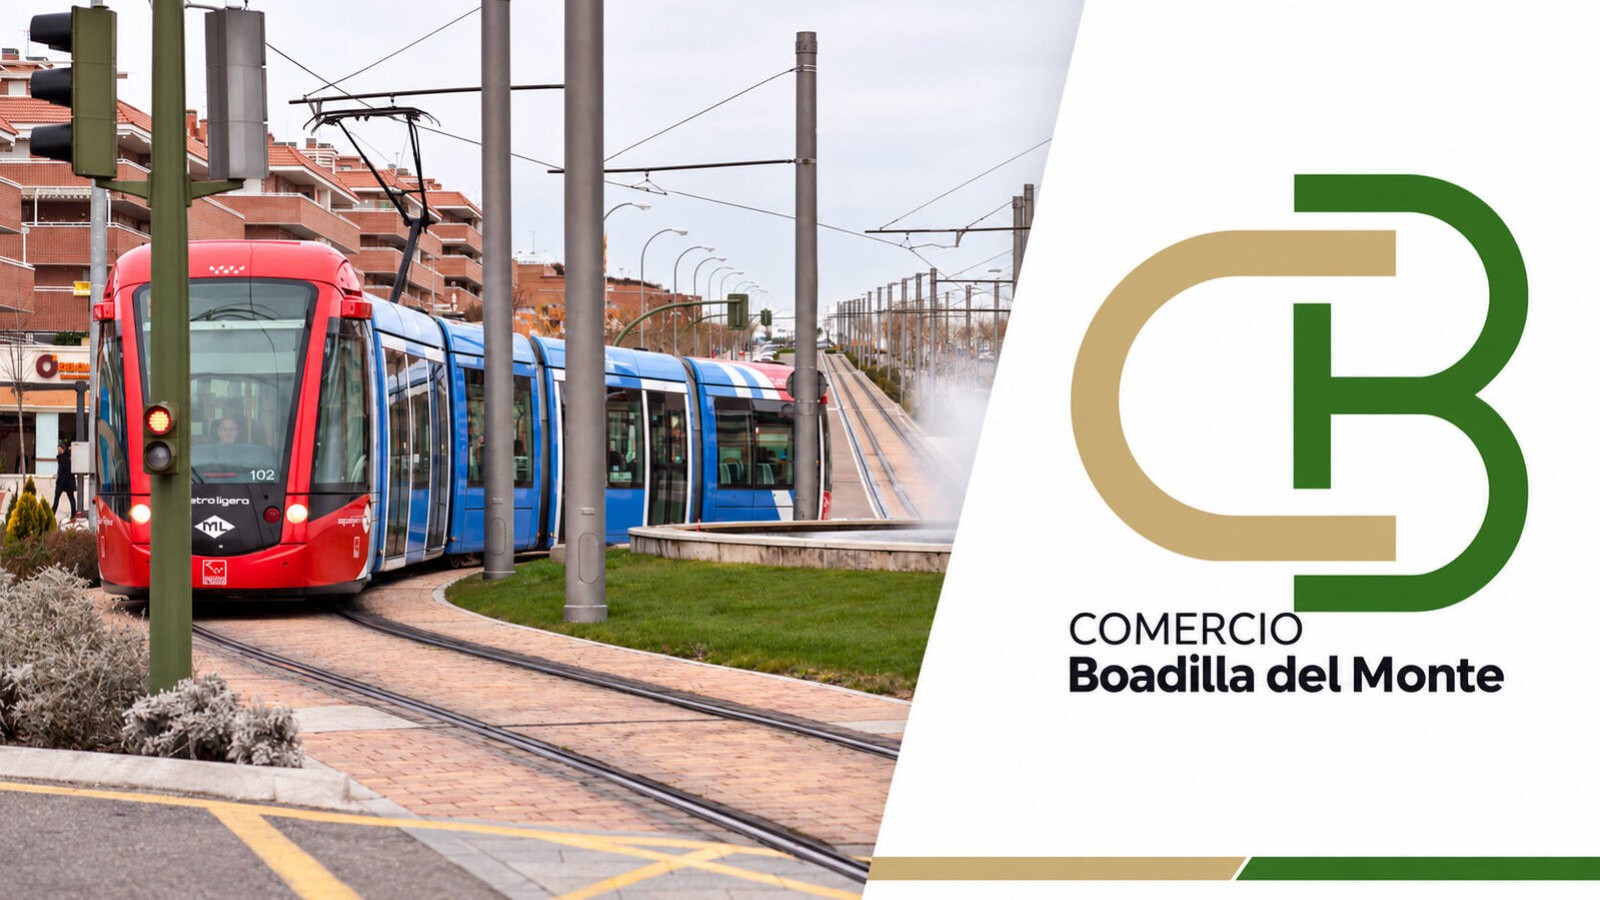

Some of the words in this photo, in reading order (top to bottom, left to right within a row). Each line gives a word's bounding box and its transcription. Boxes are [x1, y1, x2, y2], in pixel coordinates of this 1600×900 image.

[250, 469, 275, 481] 102
[190, 496, 215, 505] etro
[202, 521, 228, 532] ML
